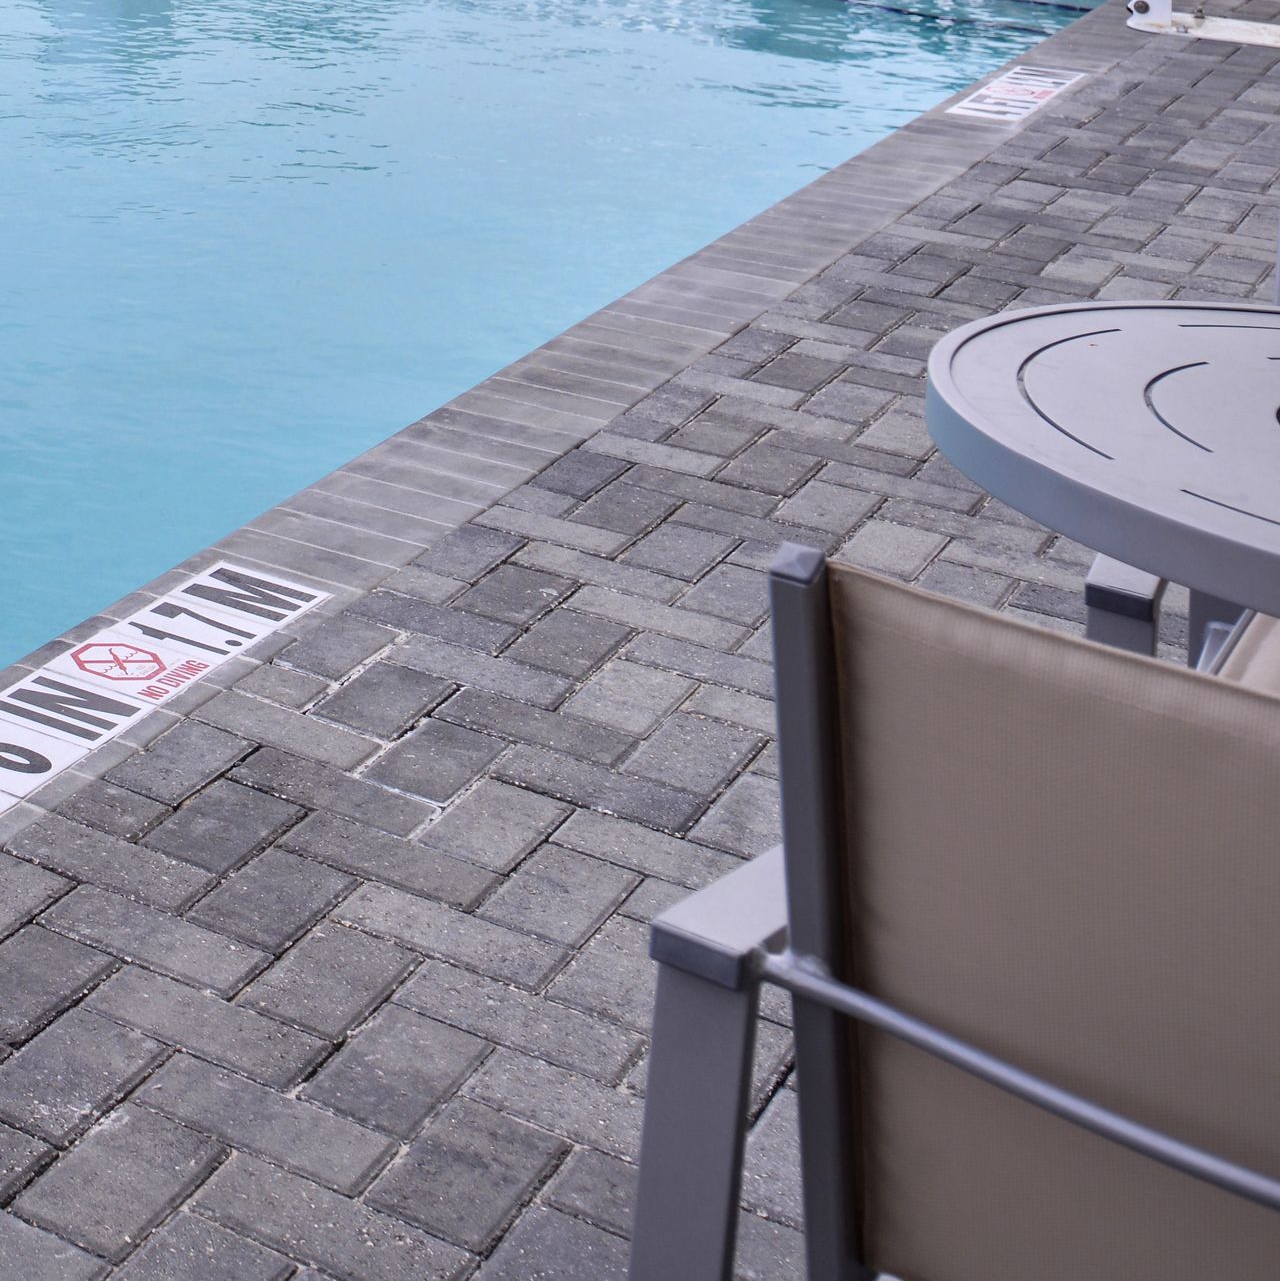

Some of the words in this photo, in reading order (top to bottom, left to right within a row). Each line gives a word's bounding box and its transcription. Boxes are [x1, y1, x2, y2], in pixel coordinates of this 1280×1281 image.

[182, 566, 316, 622] M
[137, 685, 170, 700] NO
[156, 659, 210, 688] DIVING
